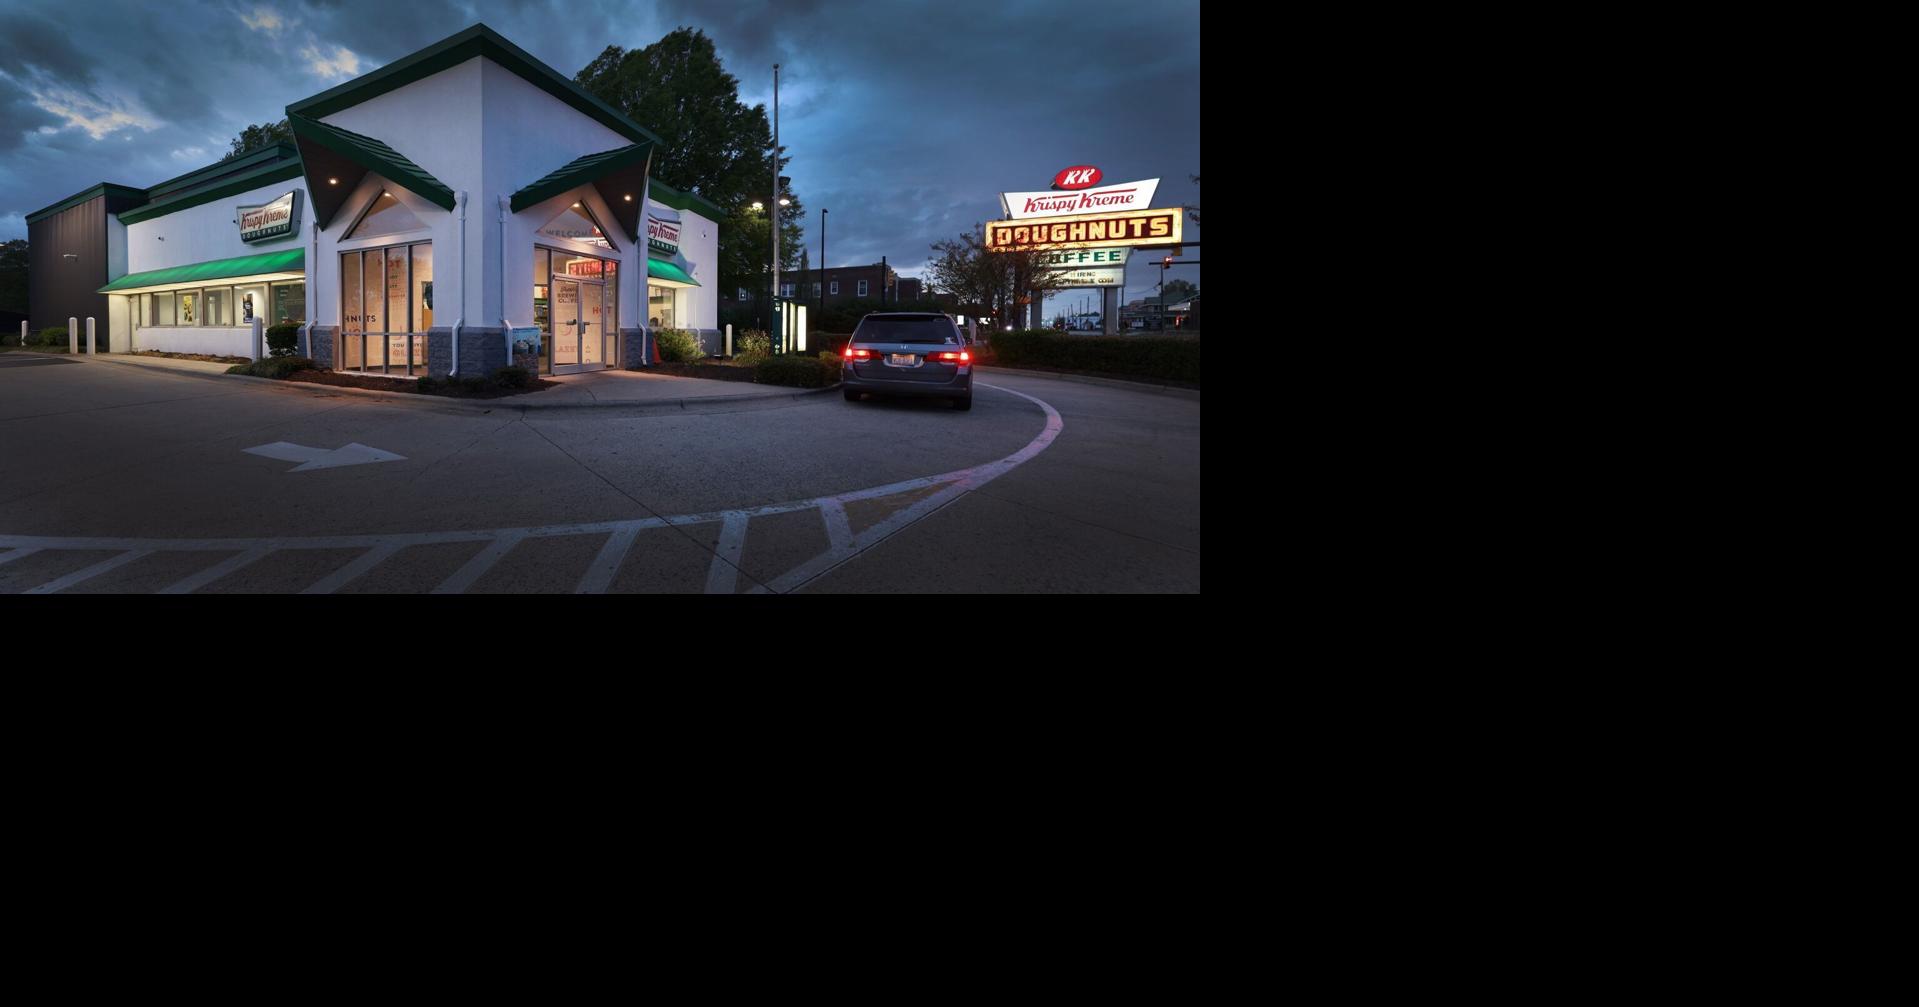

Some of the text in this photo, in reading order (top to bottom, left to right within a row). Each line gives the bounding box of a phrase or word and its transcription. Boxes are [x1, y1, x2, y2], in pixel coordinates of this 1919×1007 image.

[1063, 168, 1096, 185] KK
[1023, 188, 1138, 214] Krispy Kreme
[996, 216, 1169, 245] DOUGHNUTS
[1039, 250, 1121, 264] OFFEE
